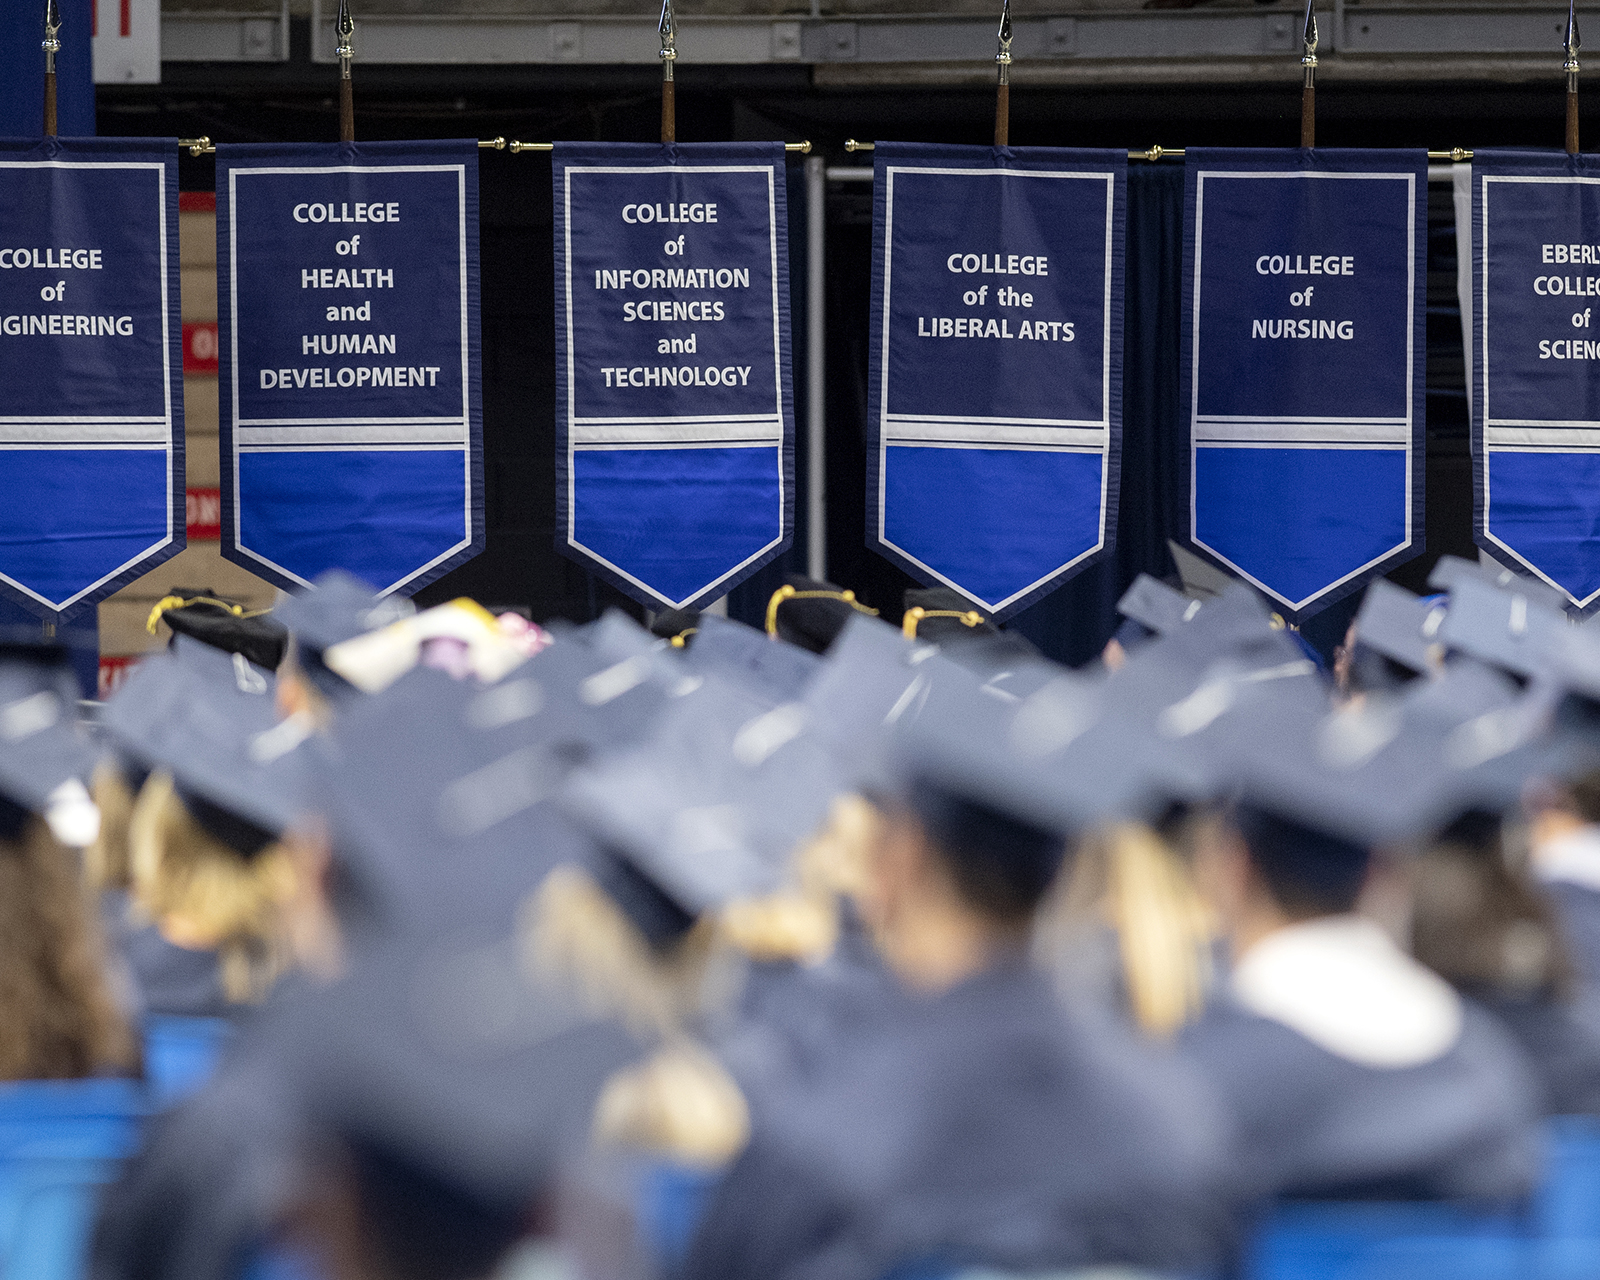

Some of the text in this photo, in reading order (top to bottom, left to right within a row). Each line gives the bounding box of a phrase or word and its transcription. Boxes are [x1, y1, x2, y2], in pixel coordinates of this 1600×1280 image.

[292, 202, 400, 223] COLLEGE
[621, 202, 718, 224] COLLEGE
[335, 234, 361, 256] of
[664, 234, 685, 256] of
[1542, 244, 1600, 265] EBERL
[0, 248, 103, 270] COLLEGE
[947, 253, 1049, 276] COLLEGE
[1255, 254, 1354, 276] COLLEGE
[301, 268, 394, 289] HEALTH
[595, 267, 750, 290] INFORMATION
[40, 280, 66, 302] of
[962, 285, 1034, 308] of the
[1289, 286, 1314, 307] of
[326, 300, 371, 322] and
[623, 300, 725, 322] SCIENCES
[1571, 307, 1591, 328] of
[0, 314, 134, 336] GINEERING
[918, 316, 1075, 342] LIBERAL ARTS
[1251, 319, 1354, 340] NURSING
[302, 334, 396, 355] HUMAN
[657, 332, 697, 354] and
[1538, 339, 1600, 360] SCIEN
[260, 366, 441, 389] DEVELOPMENT
[600, 365, 752, 388] TECHNOLOGY
